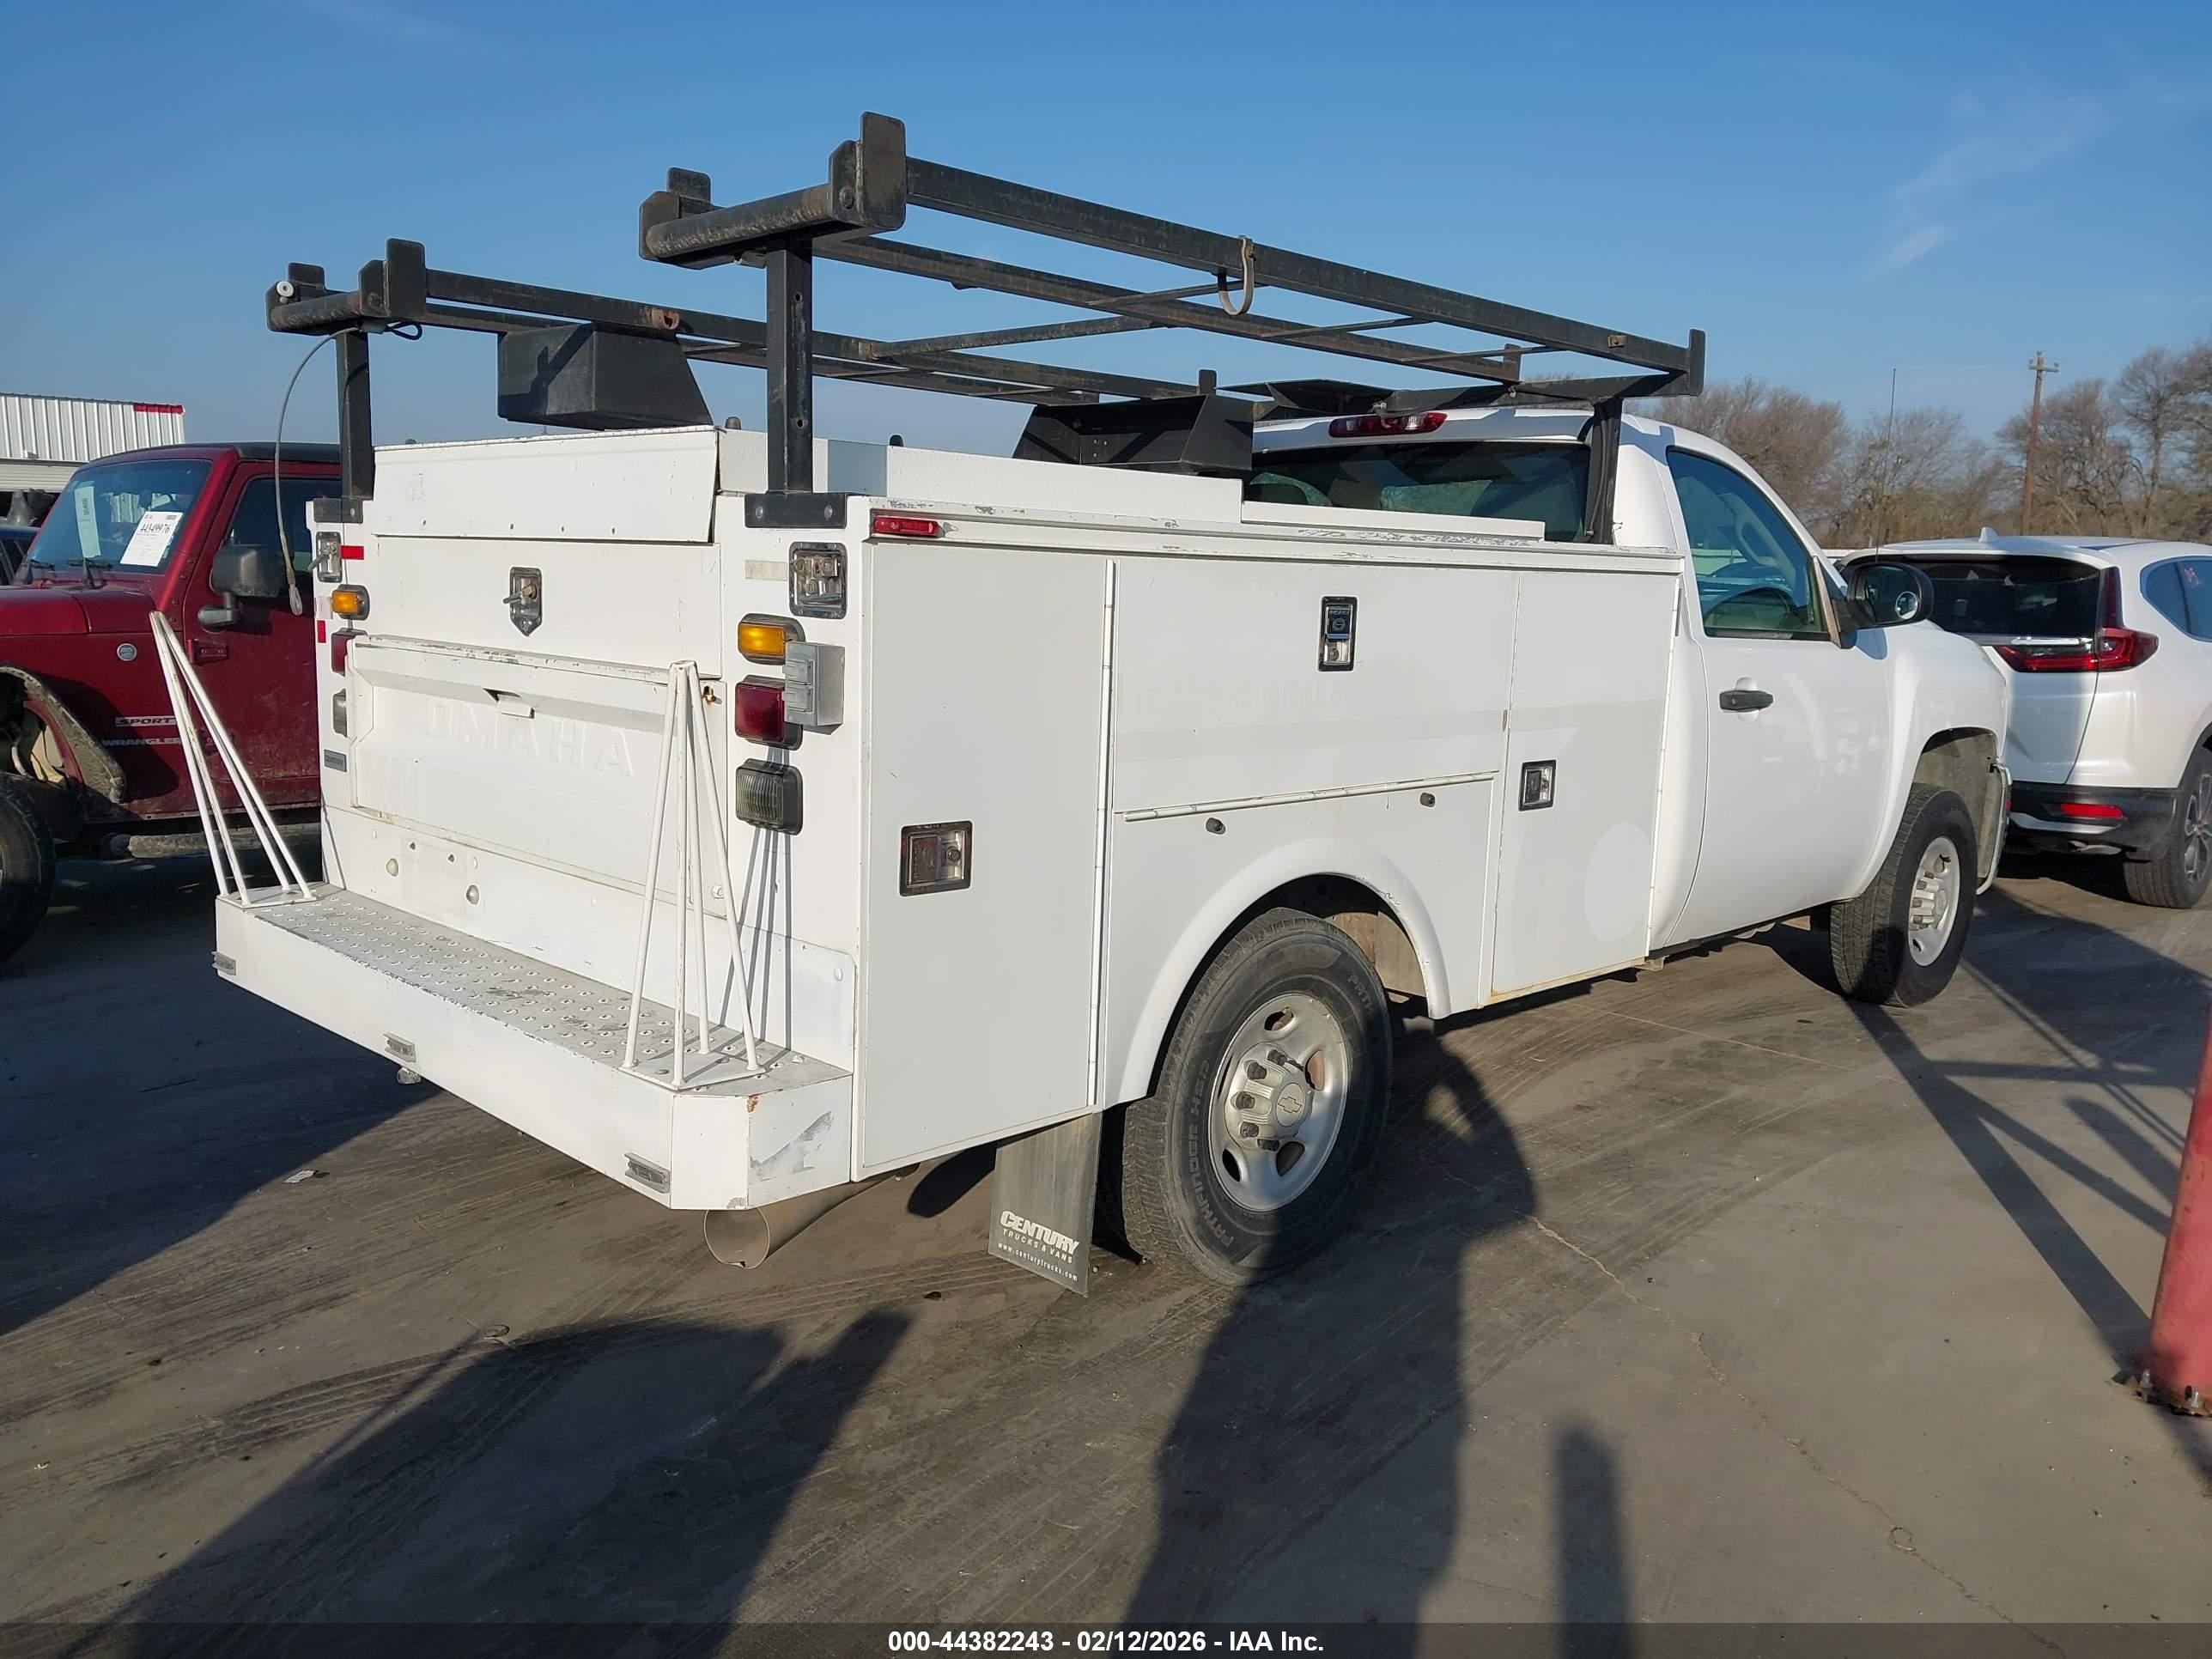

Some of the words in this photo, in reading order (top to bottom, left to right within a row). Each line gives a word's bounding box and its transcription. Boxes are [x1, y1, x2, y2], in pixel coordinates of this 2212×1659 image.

[102, 738, 182, 746] WRANGLER
[426, 700, 634, 776] OMAHA
[1000, 1210, 1080, 1255] CENTURY
[1003, 1229, 1039, 1249] TRUCKS
[1049, 1248, 1073, 1264] VANS
[998, 1243, 1078, 1282] www.centurytrucks.com
